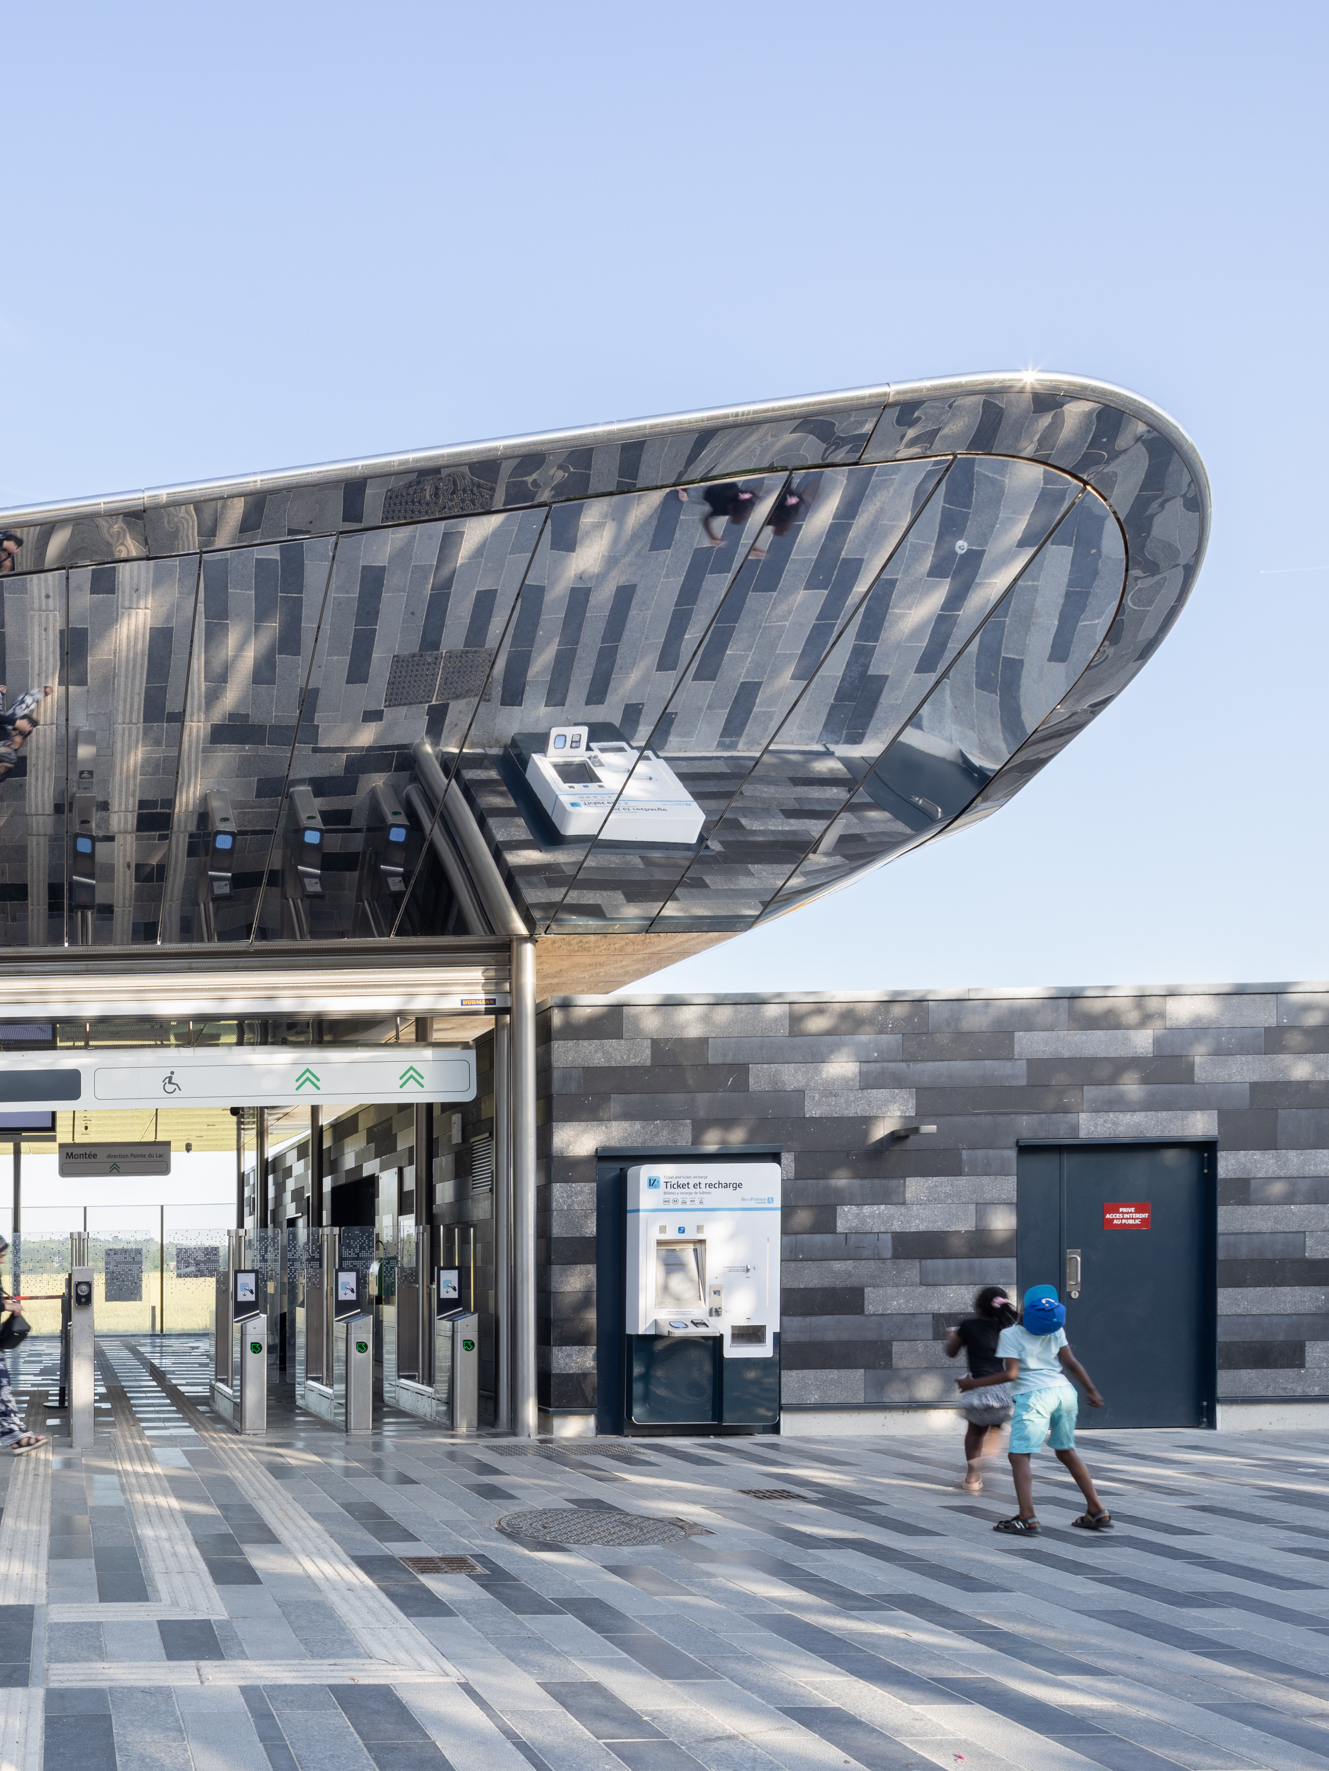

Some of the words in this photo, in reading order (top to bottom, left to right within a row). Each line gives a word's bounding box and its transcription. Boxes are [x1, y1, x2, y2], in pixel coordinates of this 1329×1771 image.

[65, 1151, 98, 1160] Montée
[663, 1181, 690, 1189] Ticket
[692, 1181, 702, 1189] et
[704, 1180, 743, 1191] recharge
